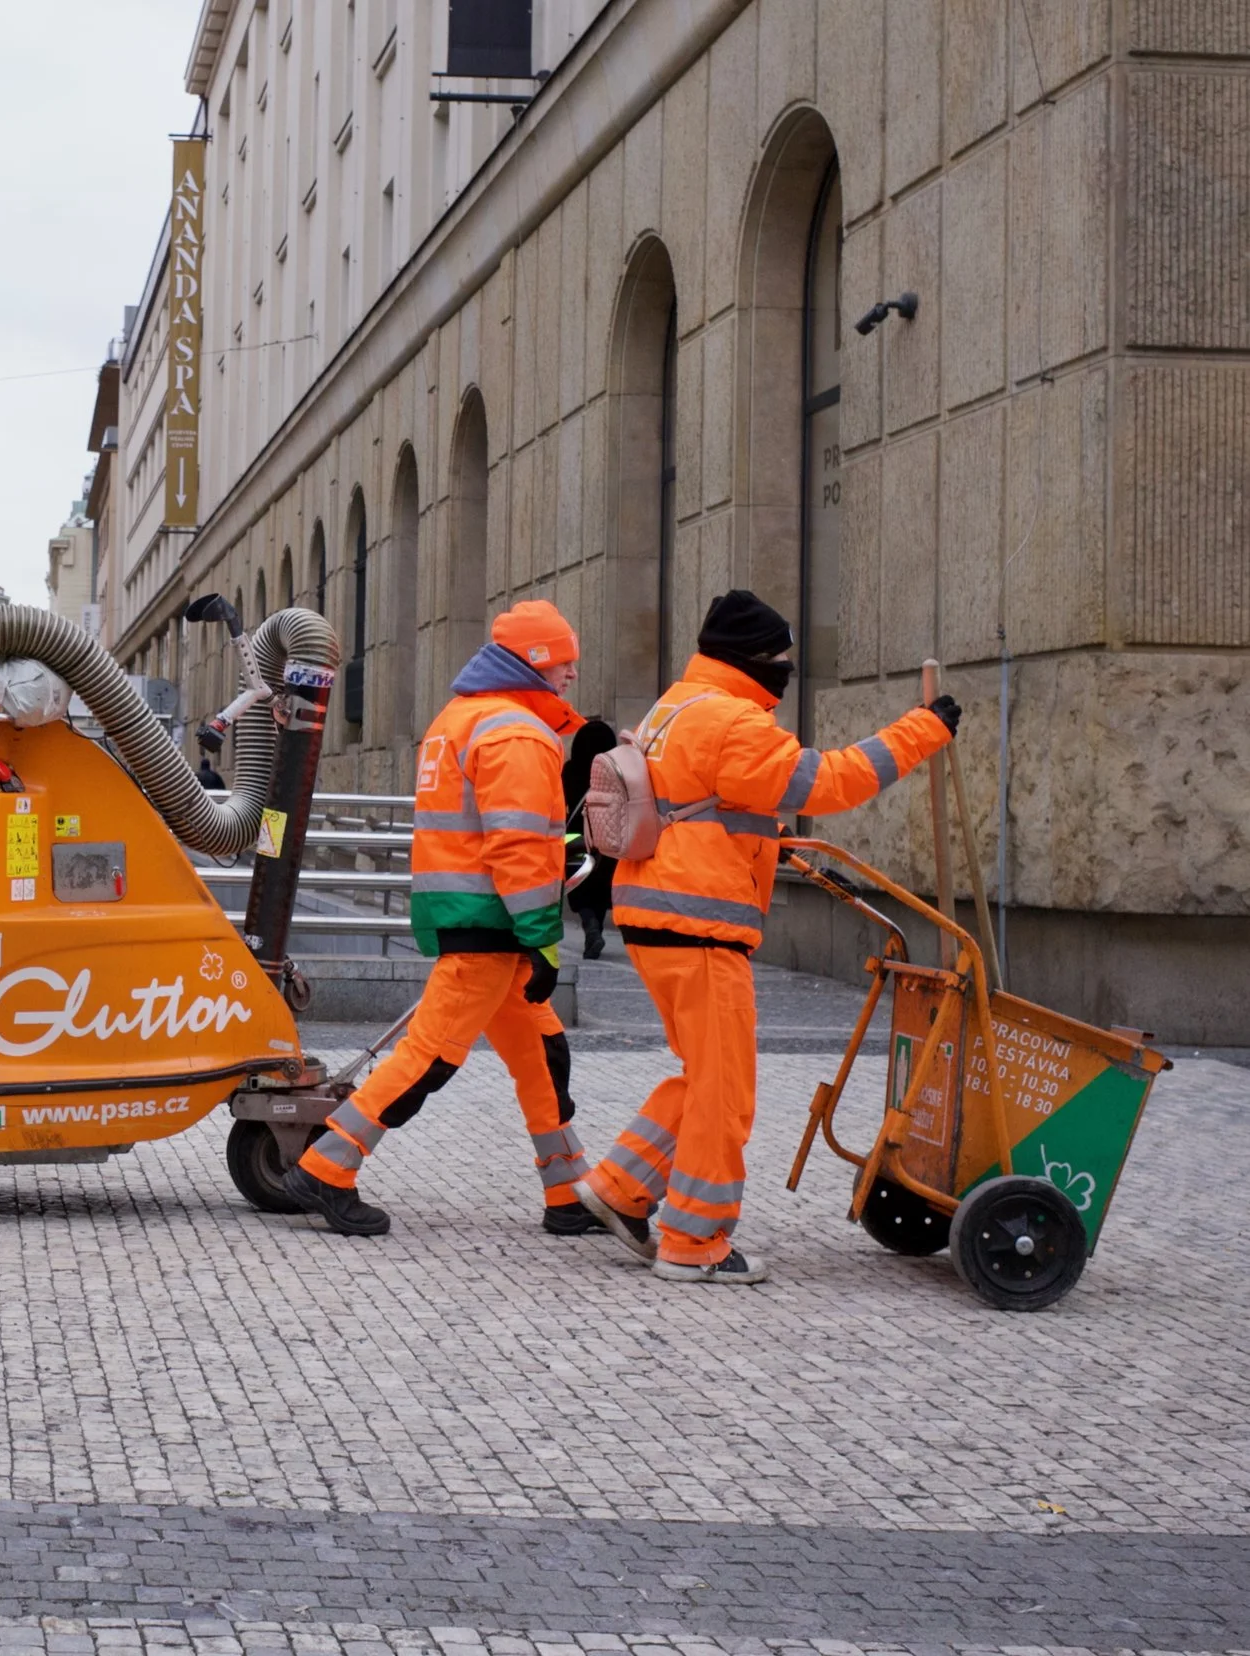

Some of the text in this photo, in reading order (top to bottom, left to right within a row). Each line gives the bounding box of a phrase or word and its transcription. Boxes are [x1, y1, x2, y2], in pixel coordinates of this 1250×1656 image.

[170, 169, 200, 415] ANANDA SPA
[973, 1036, 1070, 1080] PESTÁVKA
[1021, 1072, 1059, 1097] 10.30
[22, 1095, 190, 1126] www.psas.cz
